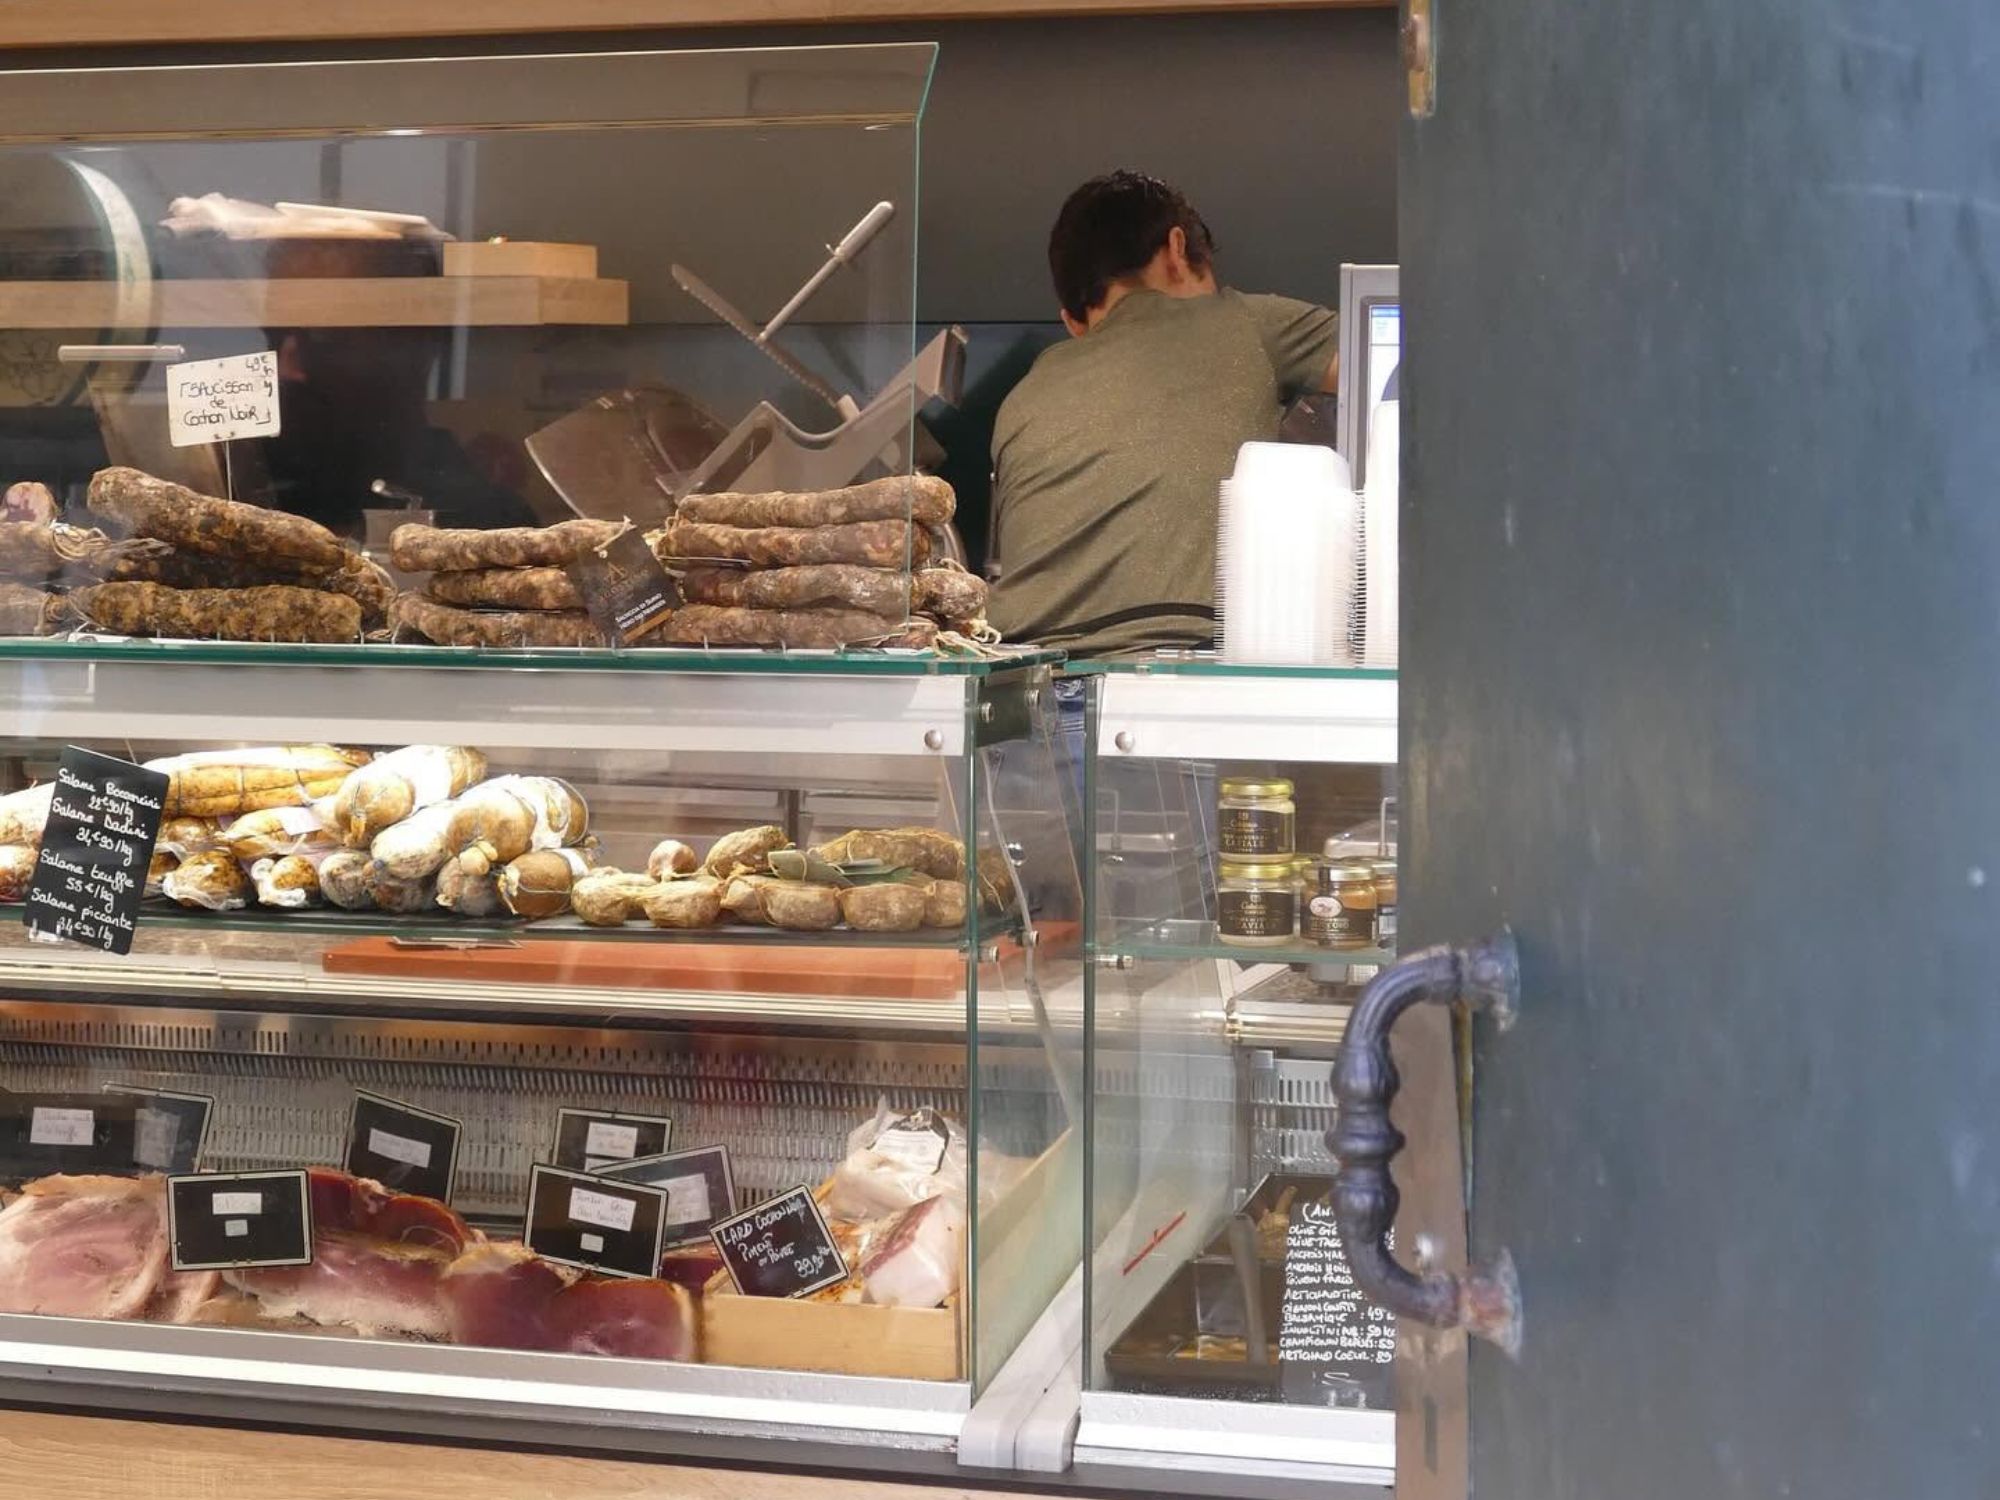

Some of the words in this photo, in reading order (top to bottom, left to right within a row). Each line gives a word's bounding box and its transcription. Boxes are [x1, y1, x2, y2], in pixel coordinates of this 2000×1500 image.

[210, 396, 227, 409] de
[58, 767, 96, 792] Salame
[52, 796, 95, 824] Salame
[40, 848, 85, 875] Salame
[30, 888, 77, 913] Salame
[80, 905, 134, 930] piccante
[721, 1222, 753, 1245] LARD
